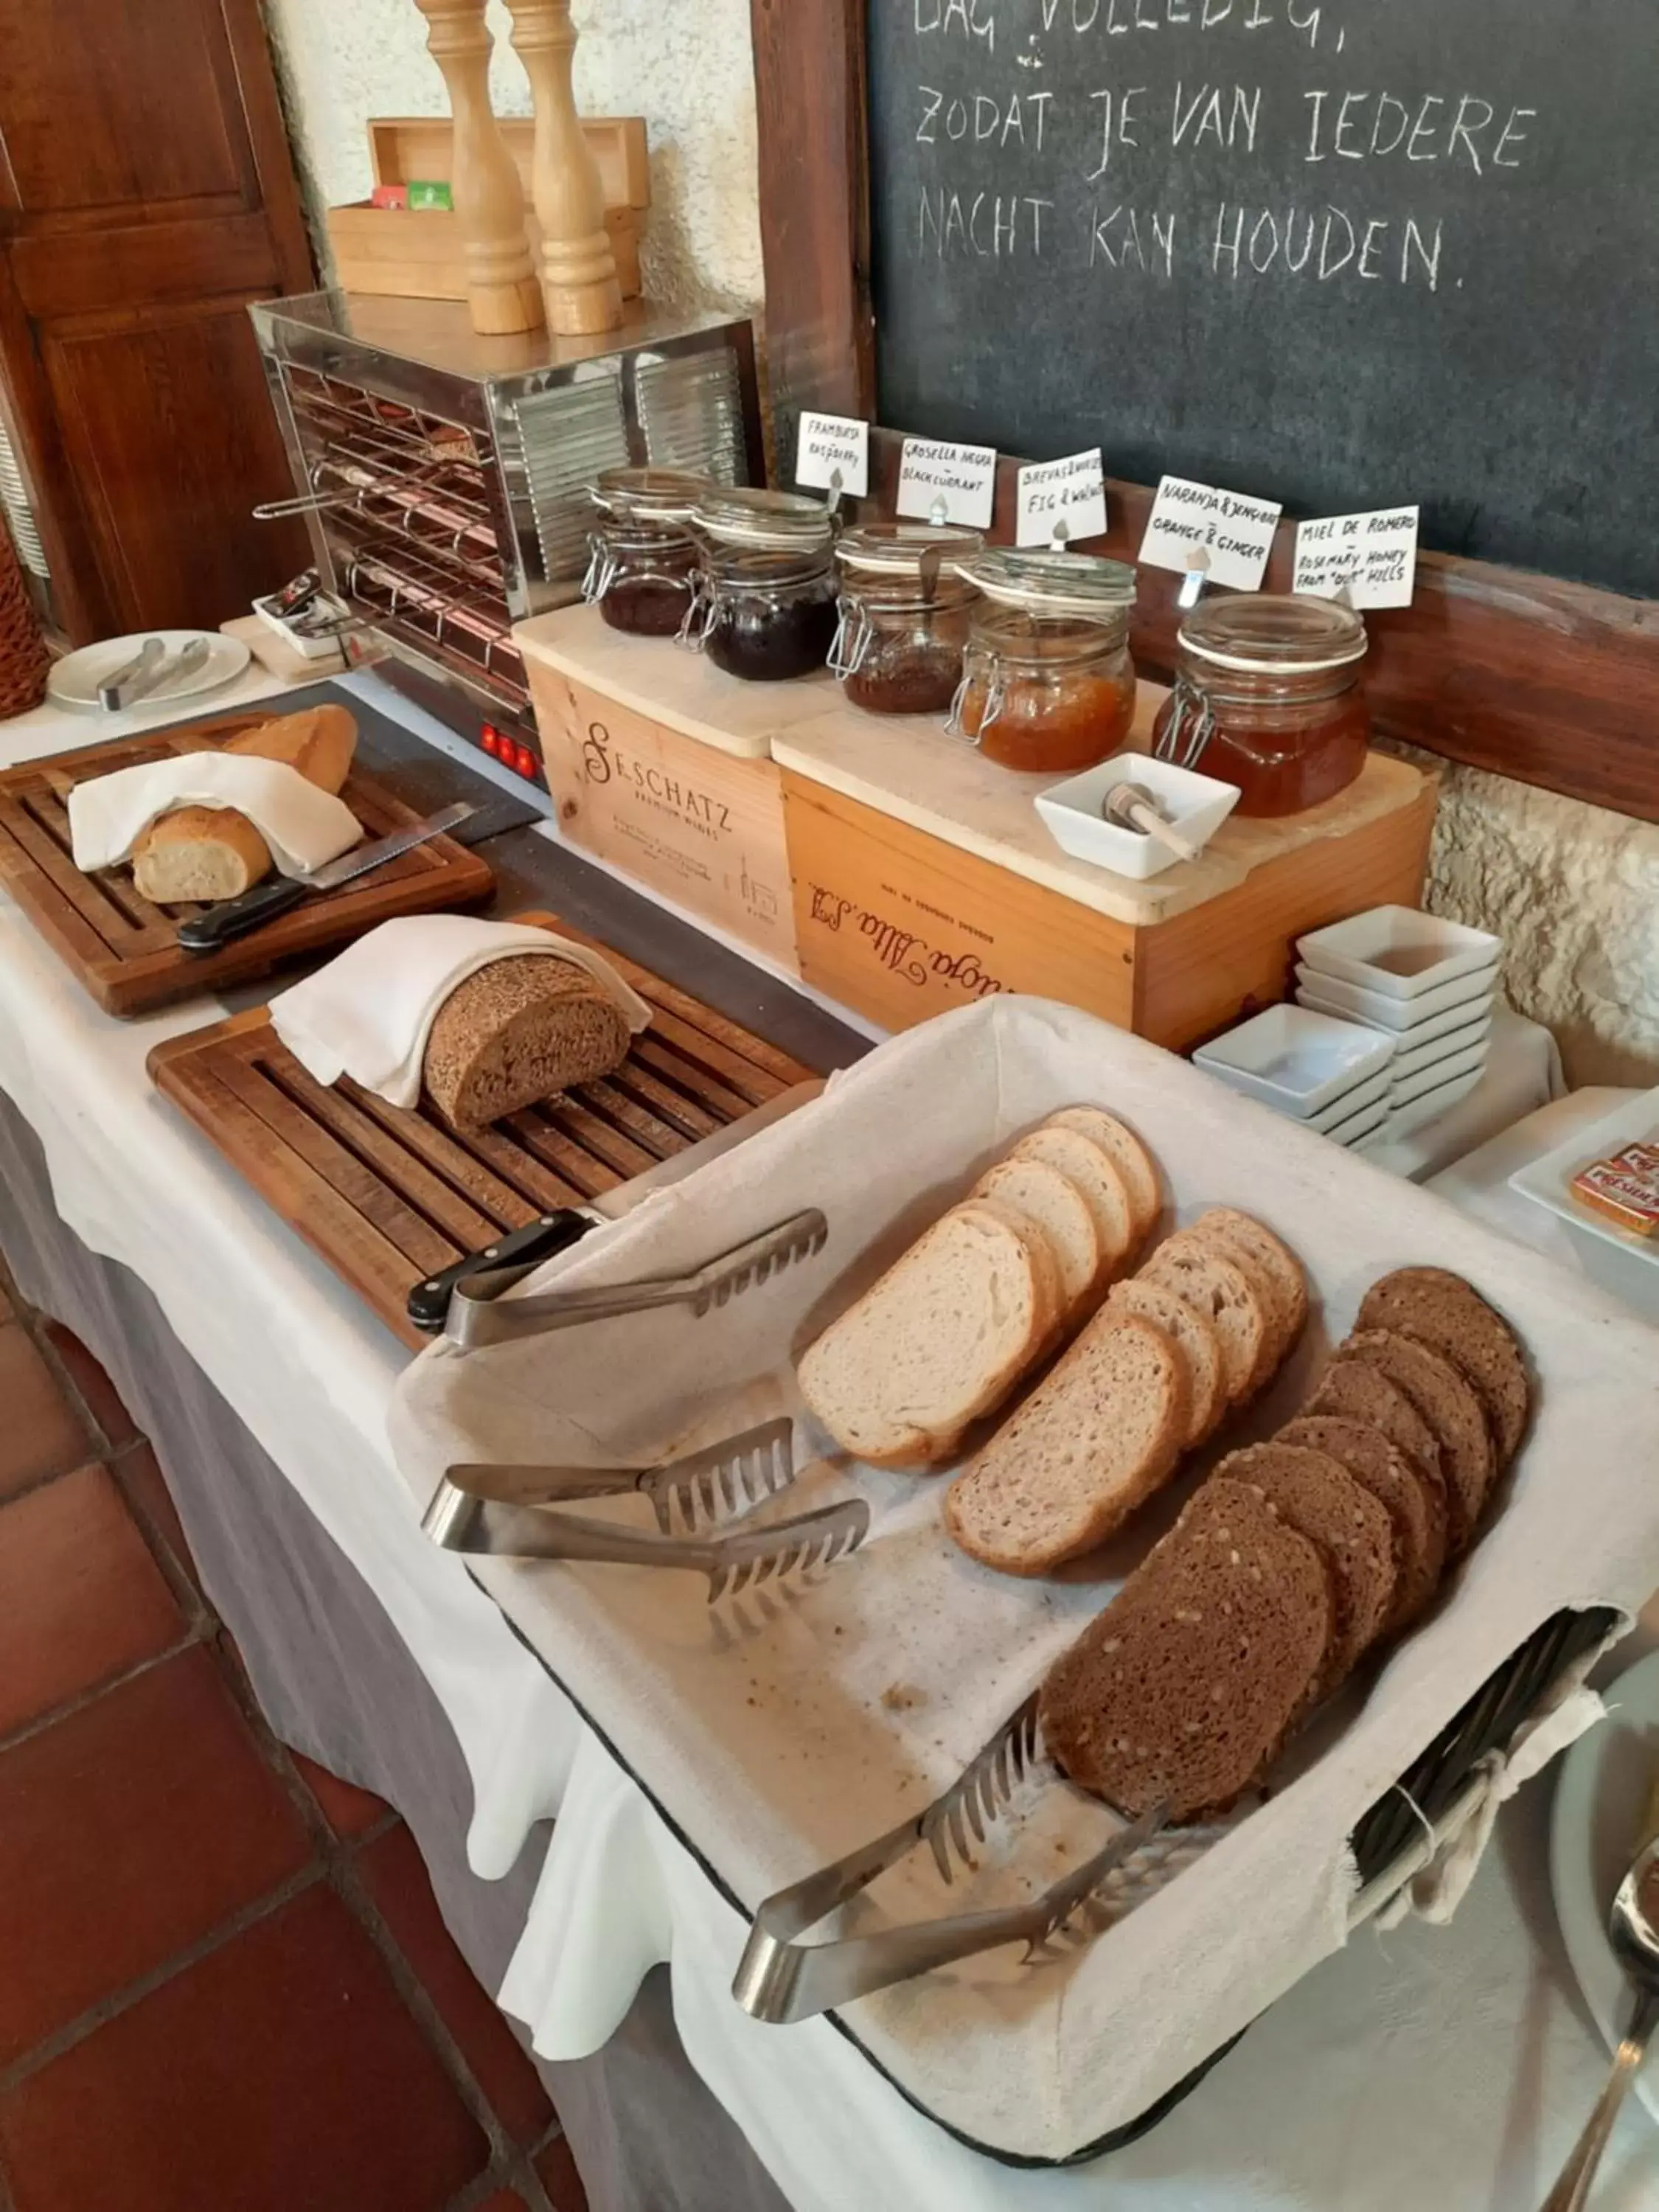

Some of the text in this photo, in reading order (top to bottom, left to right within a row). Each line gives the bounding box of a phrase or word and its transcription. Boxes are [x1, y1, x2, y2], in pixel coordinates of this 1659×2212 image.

[917, 80, 1537, 181] ZODAT JE VAN IEDERE
[919, 185, 1054, 258] NACHT
[1212, 201, 1464, 293] HOUDEN.
[1027, 493, 1056, 514] FIG
[1161, 483, 1219, 511] NARANJA
[1152, 516, 1266, 560] ORANGE & GINGER
[1342, 520, 1360, 536] DE
[1366, 549, 1408, 566] HONEY
[1366, 566, 1405, 584] HILLS
[928, 950, 1015, 1003] ioja
